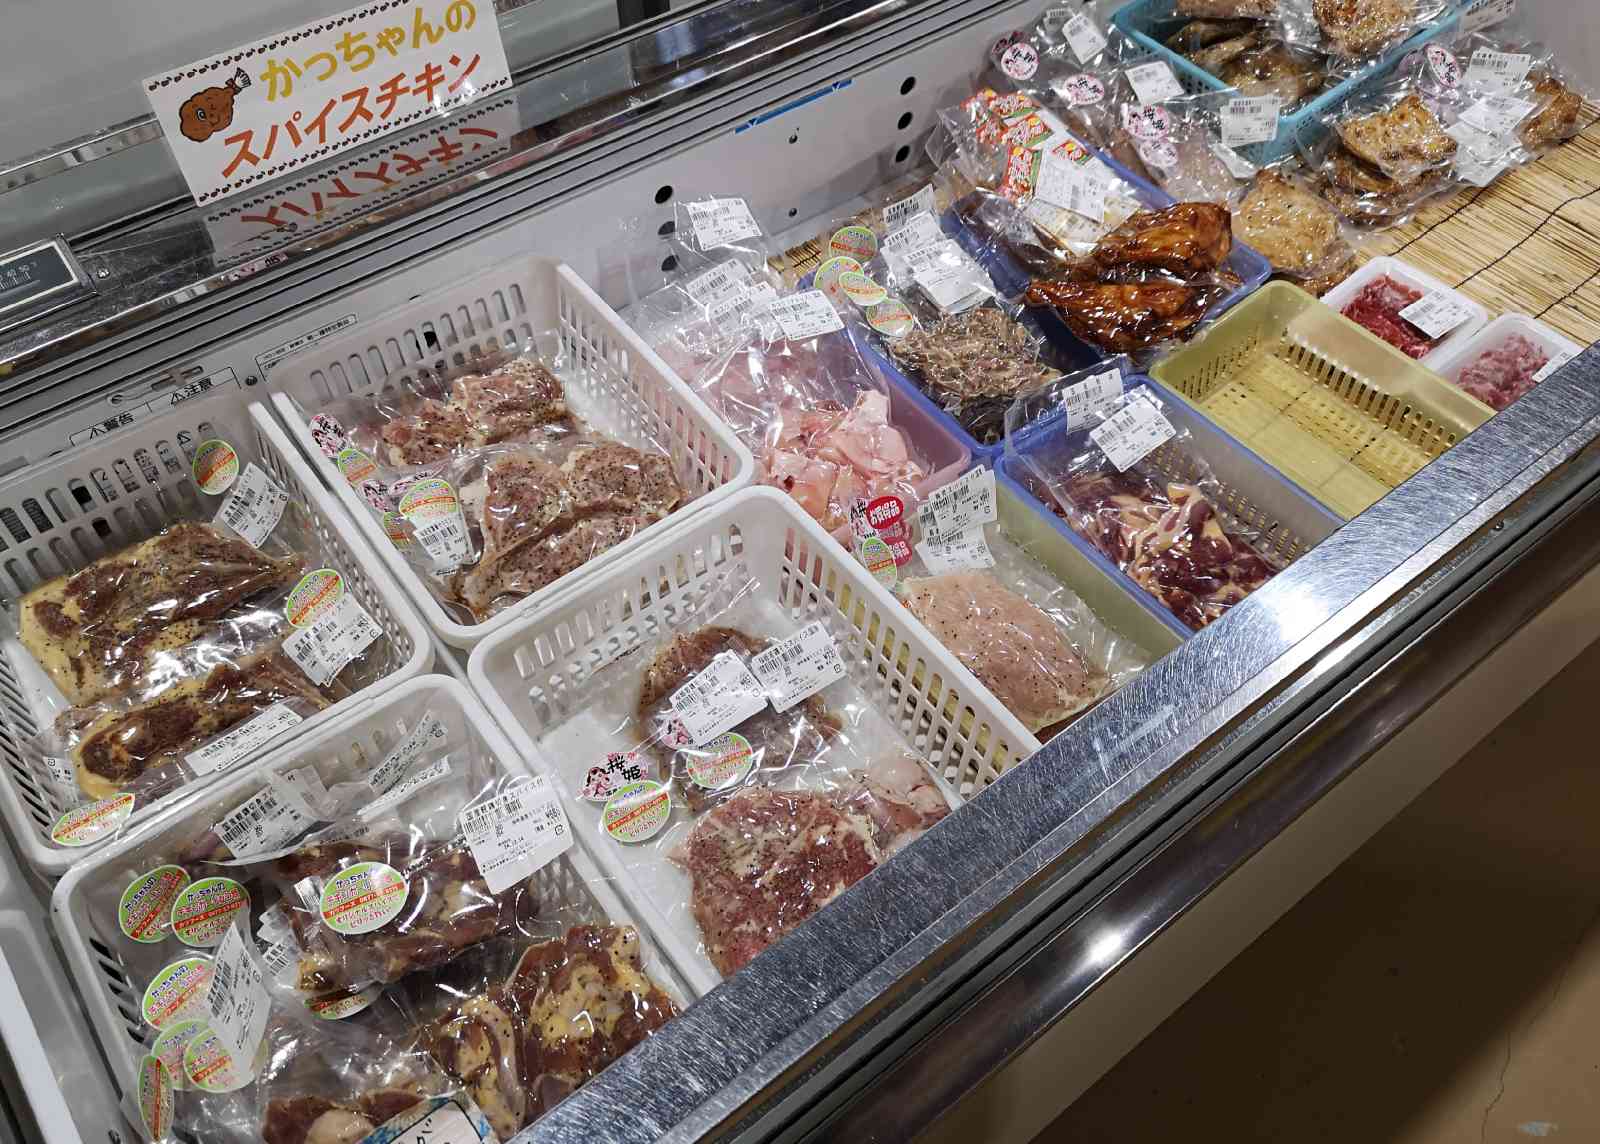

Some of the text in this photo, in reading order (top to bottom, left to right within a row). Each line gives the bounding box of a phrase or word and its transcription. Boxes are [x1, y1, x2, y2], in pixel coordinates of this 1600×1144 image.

[259, 0, 477, 103] かっちゃんの
[221, 52, 482, 179] スパイスチキン
[183, 376, 213, 397] 注意
[104, 411, 135, 430] 警告
[607, 755, 643, 782] 桜姫
